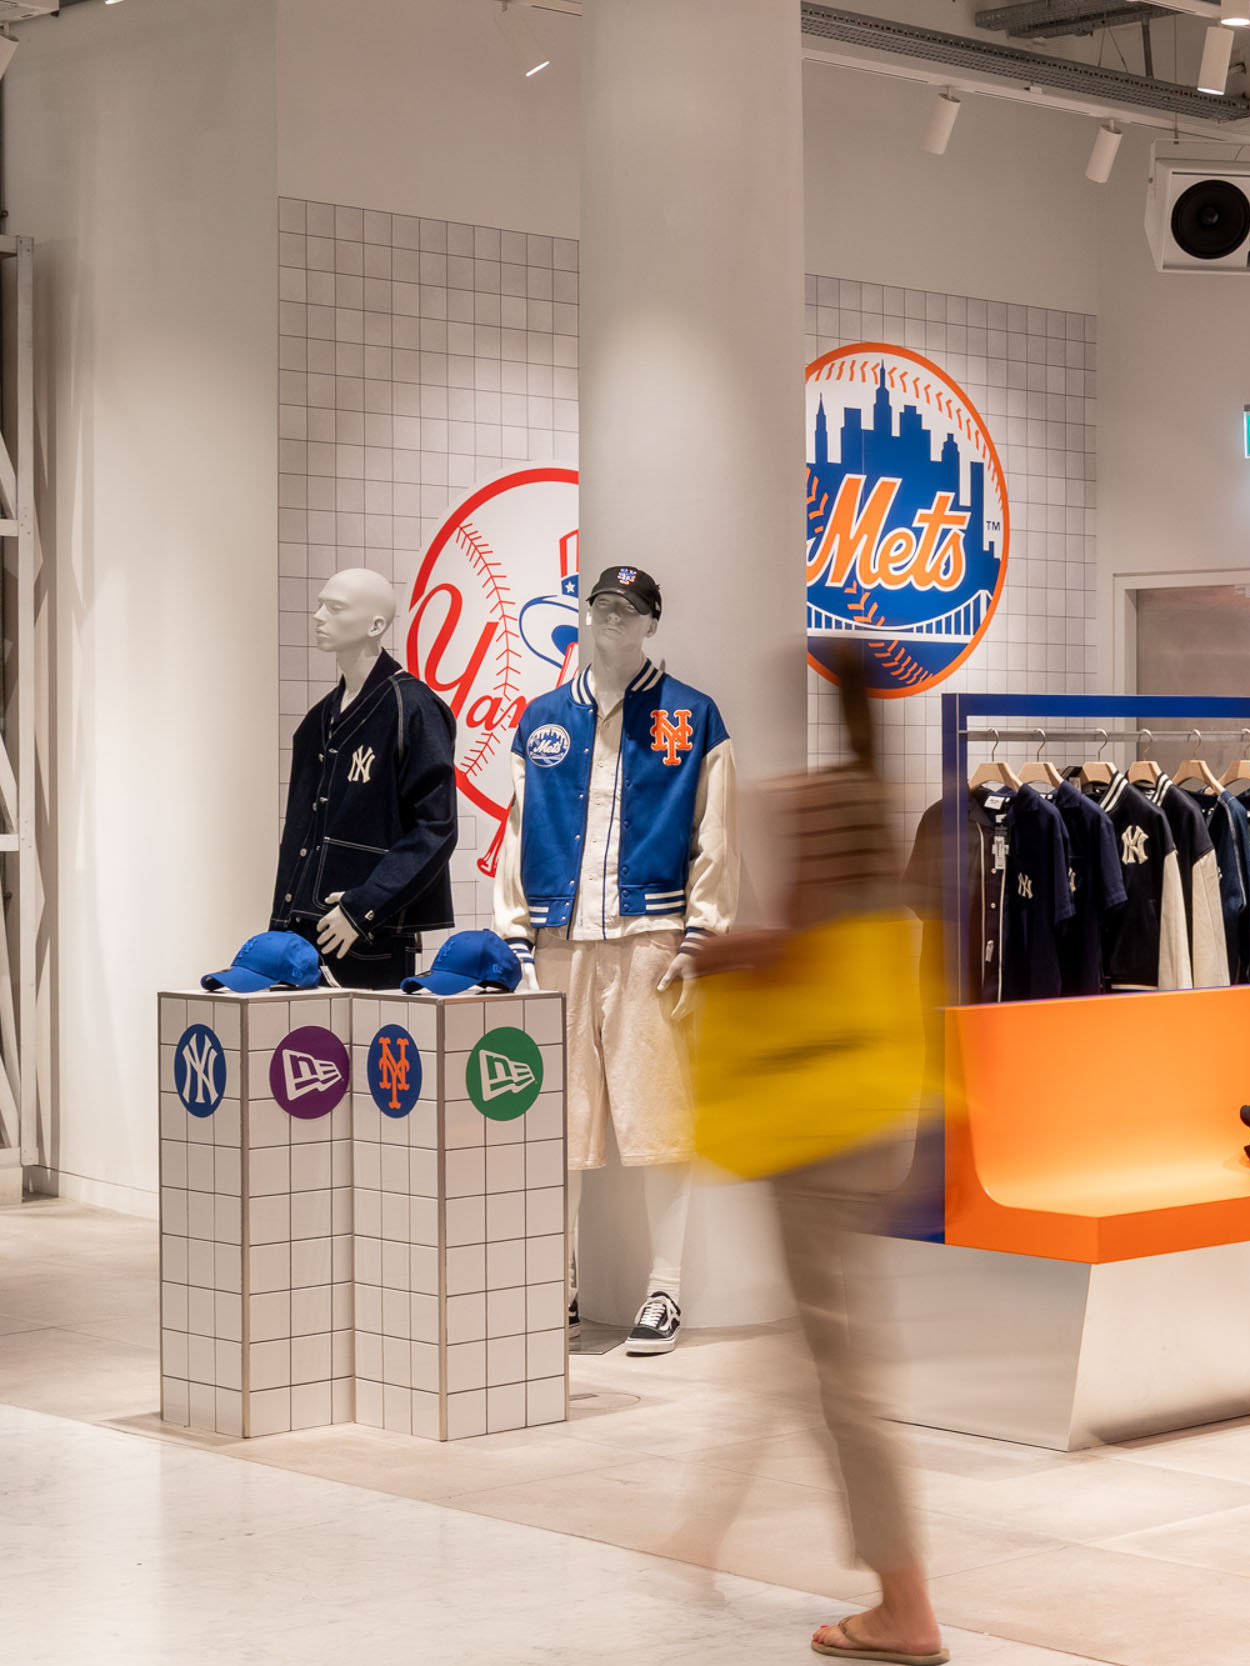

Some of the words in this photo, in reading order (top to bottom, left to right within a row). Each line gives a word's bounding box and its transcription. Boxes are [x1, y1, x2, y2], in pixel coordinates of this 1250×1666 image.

[806, 473, 972, 591] Mets
[986, 521, 1000, 531] TM
[533, 740, 562, 754] Mets
[650, 709, 694, 766] NY
[347, 744, 376, 784] NY
[181, 1032, 219, 1105] NY
